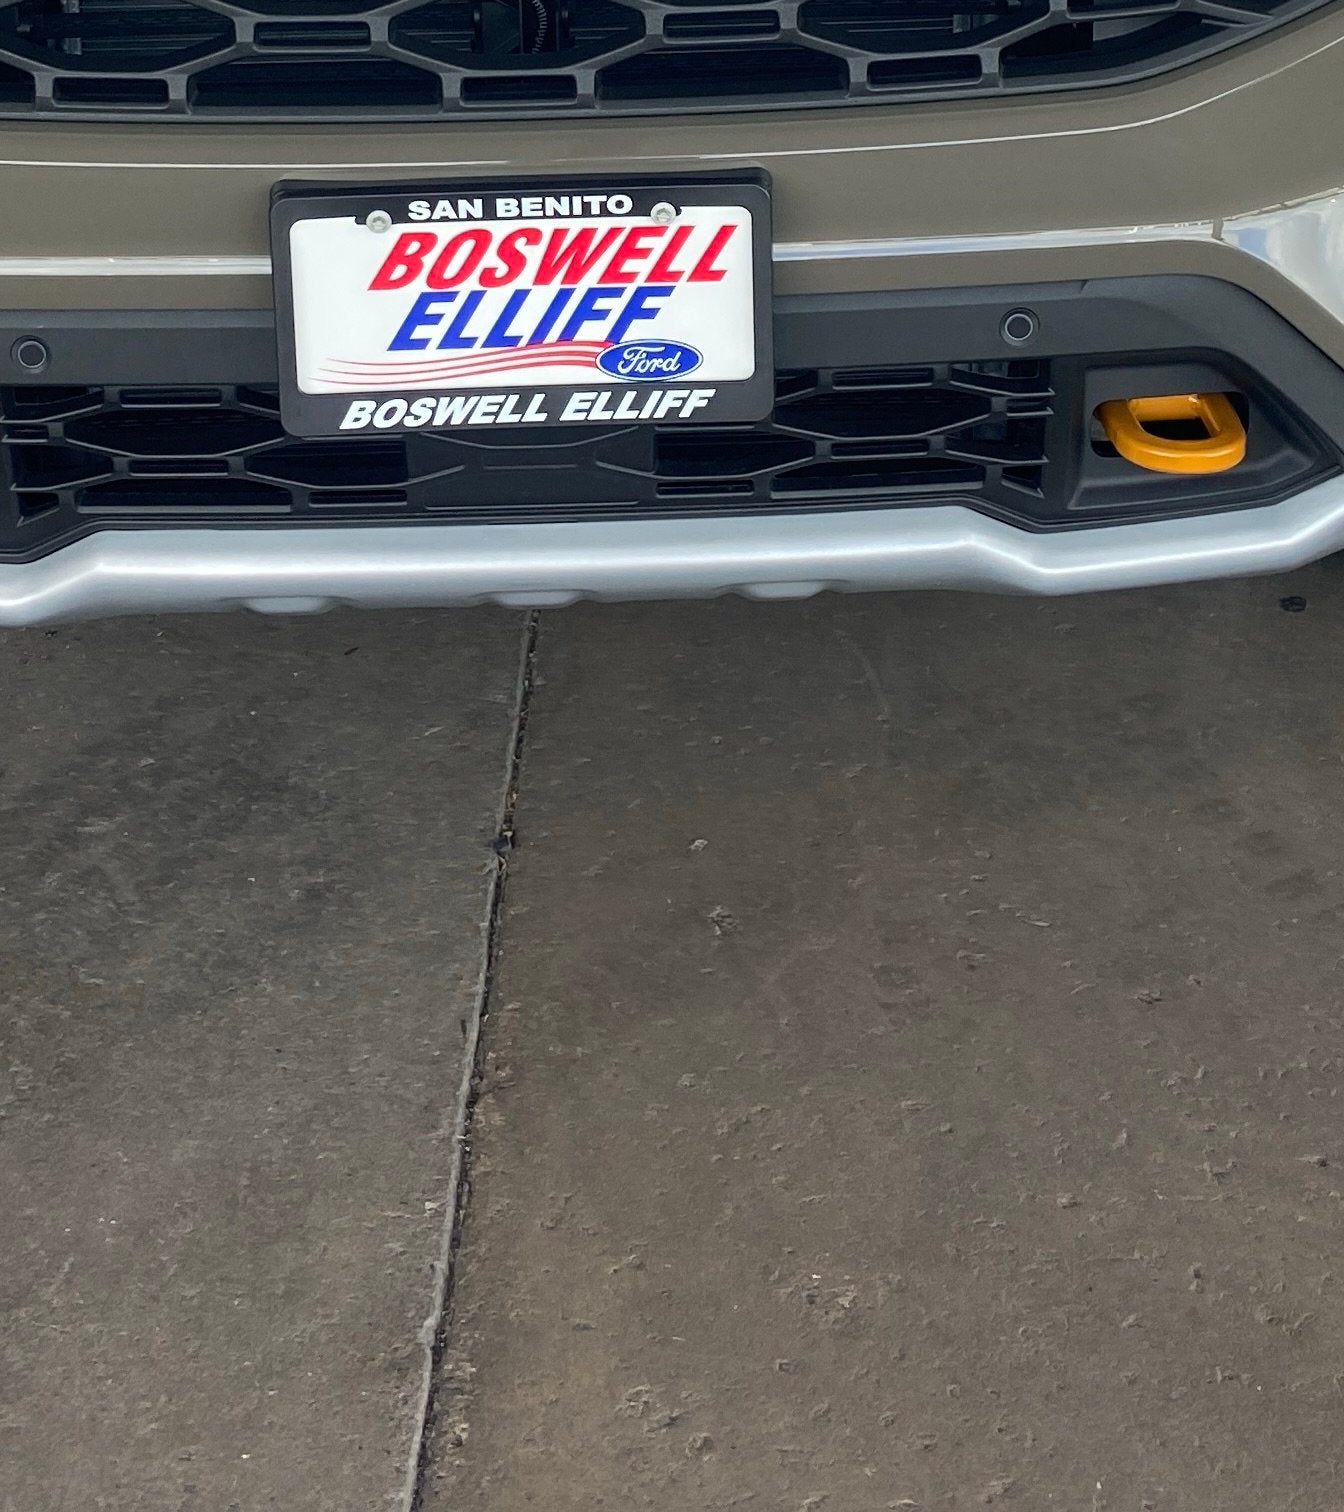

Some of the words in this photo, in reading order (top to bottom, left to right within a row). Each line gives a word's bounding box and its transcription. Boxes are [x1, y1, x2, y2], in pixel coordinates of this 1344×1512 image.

[408, 198, 483, 221] SAN
[495, 194, 633, 218] BENITO
[368, 225, 737, 290] BOSWELL
[386, 285, 676, 352] ELLIFF
[617, 346, 682, 374] Ford
[340, 393, 549, 430] BOSWELL
[559, 388, 717, 422] ELLIFF
